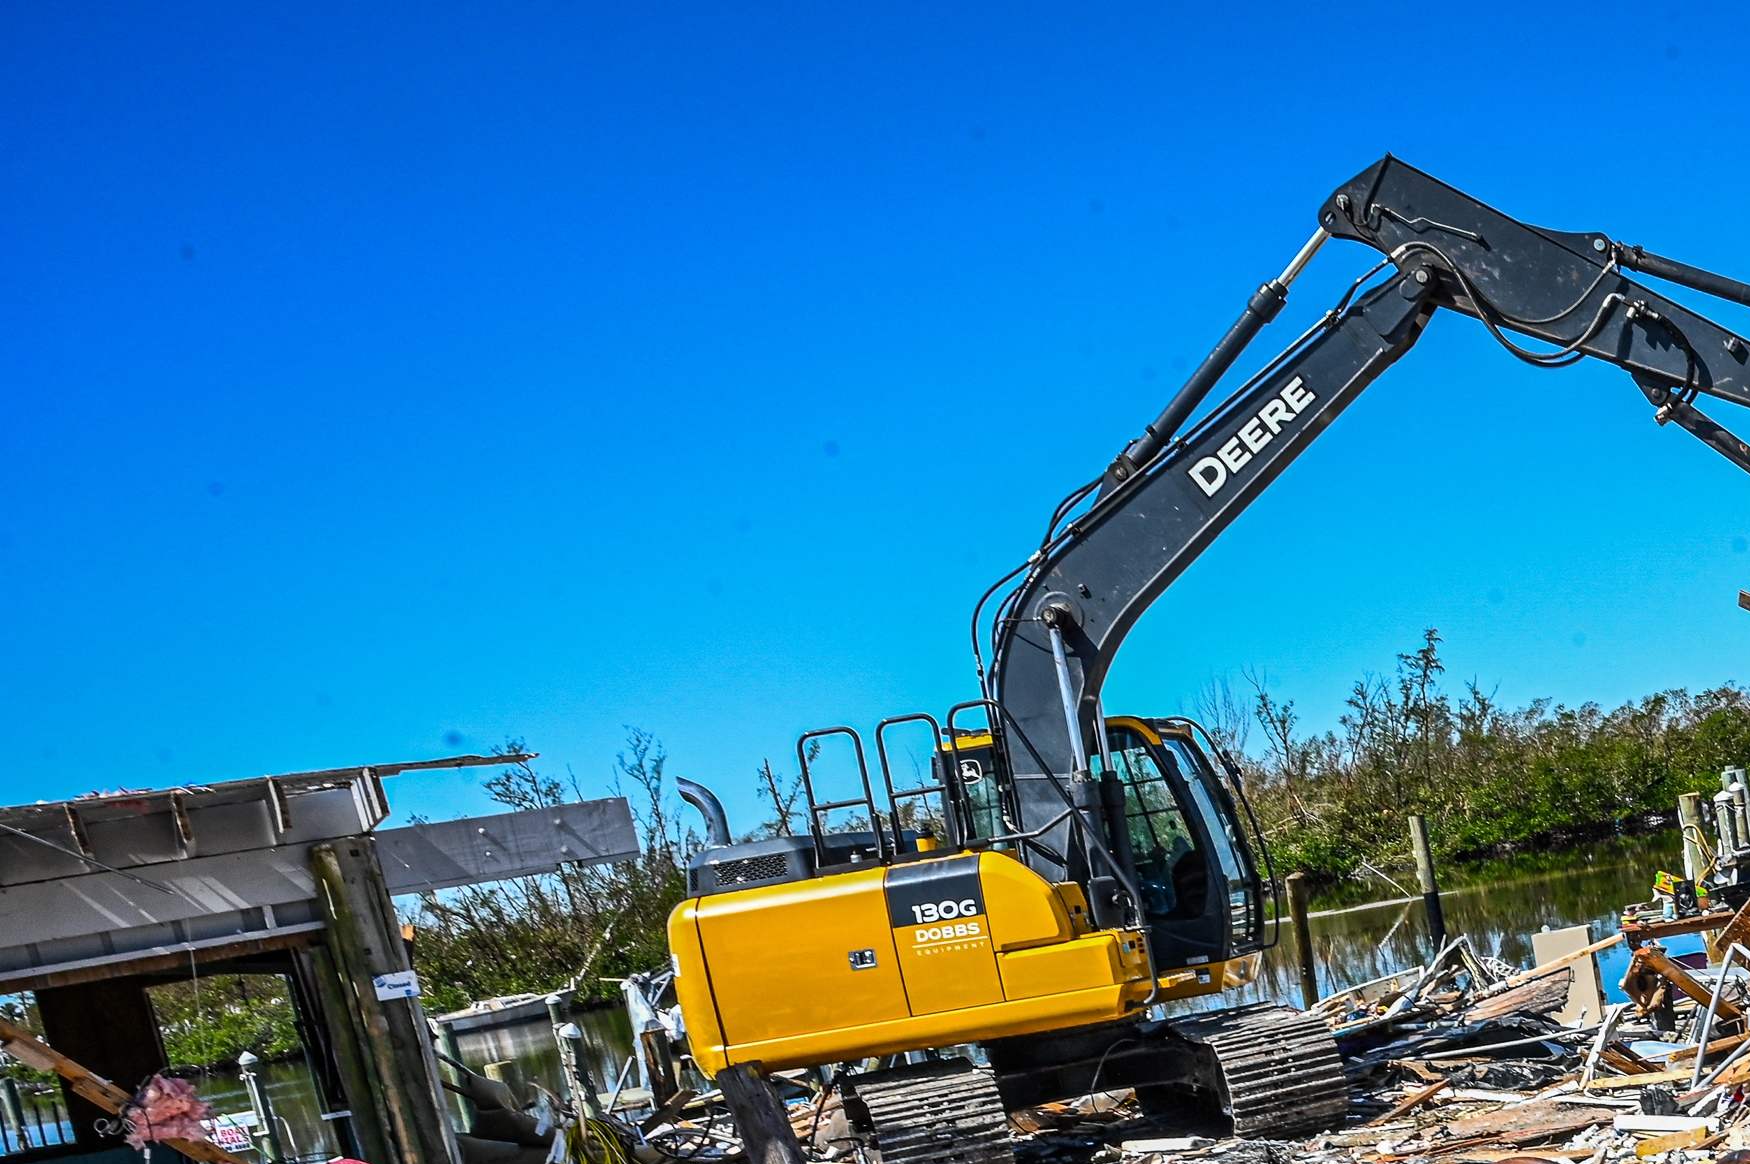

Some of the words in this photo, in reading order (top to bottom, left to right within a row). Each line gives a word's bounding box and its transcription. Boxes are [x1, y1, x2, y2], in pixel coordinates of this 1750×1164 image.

[1188, 376, 1316, 498] DEERE
[911, 899, 977, 924] 130G
[914, 922, 981, 942] DOBBS
[916, 941, 985, 956] EQUIPMENT
